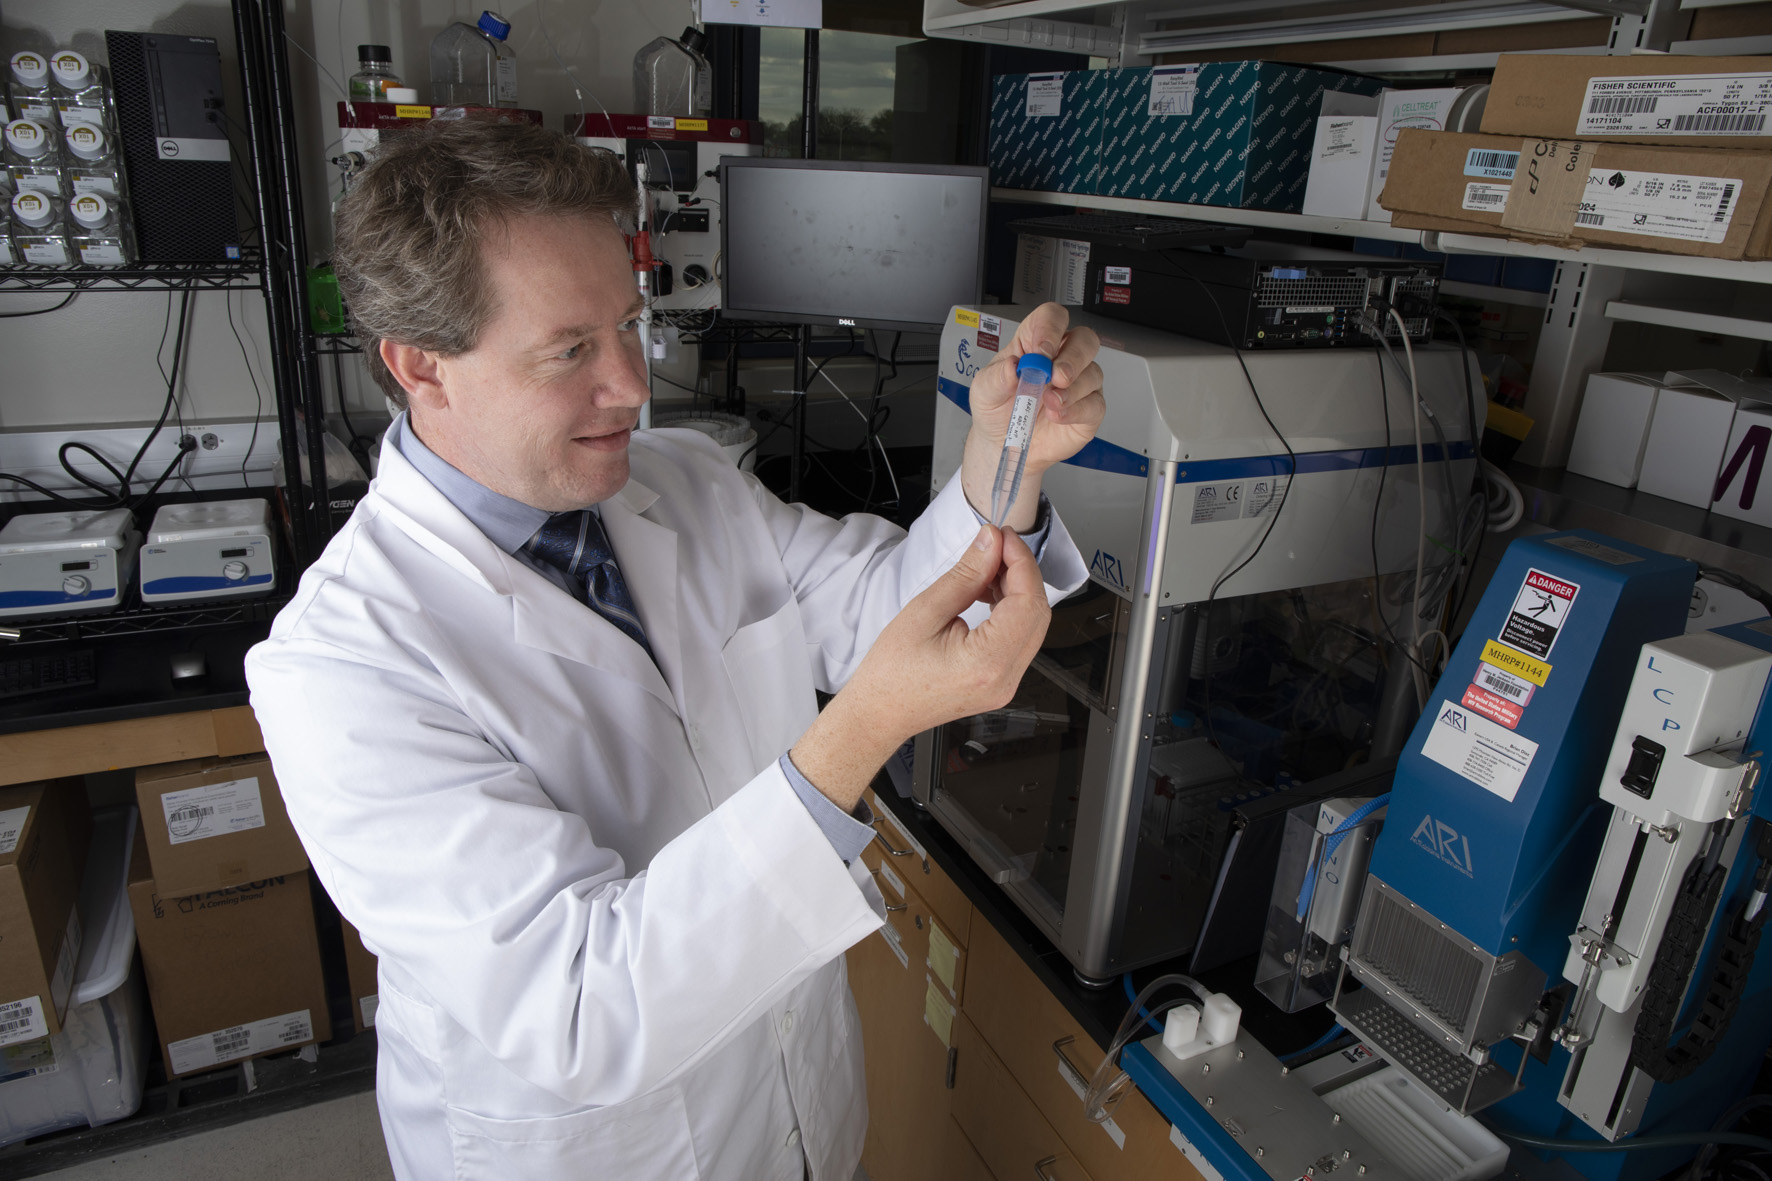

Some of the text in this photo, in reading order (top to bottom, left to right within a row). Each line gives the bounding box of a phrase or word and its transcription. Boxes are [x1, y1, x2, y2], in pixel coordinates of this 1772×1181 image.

[1084, 67, 1101, 92] QIAGEN
[1228, 60, 1250, 85] QIAGEN
[1268, 71, 1288, 94] QIAGEN
[1004, 82, 1016, 101] QIAGEN
[1068, 81, 1081, 102] QIAGEN
[1122, 76, 1138, 98] QIAGEN
[1205, 73, 1224, 98] QIAGEN
[1240, 80, 1262, 106] QIAGEN
[1626, 81, 1676, 90] SCIENTIFIC
[1012, 98, 1023, 117] QIAGEN
[1076, 98, 1090, 119] QIAGEN
[1132, 94, 1146, 116] QIAGEN
[1215, 94, 1234, 118] QIAGEN
[1253, 104, 1275, 128] QIAGEN
[1280, 94, 1300, 117] QIAGEN
[1401, 101, 1438, 112] CELLTREAT
[1059, 110, 1072, 130] QIAGEN
[1085, 116, 1099, 137] QIAGEN
[1113, 106, 1128, 128] QIAGEN
[1192, 108, 1210, 131] QIAGEN
[1226, 114, 1246, 139] QIAGEN
[1027, 131, 1039, 150] QIAGEN
[1042, 121, 1055, 140] QIAGEN
[1067, 128, 1081, 148] QIAGEN
[1122, 124, 1136, 146] QIAGEN
[1170, 120, 1187, 143] QIAGEN
[1202, 128, 1221, 152] QIAGEN
[1266, 127, 1286, 150] QIAGEN
[1051, 138, 1064, 158] QIAGEN
[1104, 136, 1118, 157] QIAGEN
[1130, 144, 1146, 165] QIAGEN
[1150, 132, 1166, 155] QIAGEN
[1181, 140, 1198, 163] QIAGEN
[1238, 137, 1261, 160] QIAGEN
[1059, 155, 1072, 175] QIAGEN
[1076, 145, 1090, 166] QIAGEN
[1112, 154, 1126, 176] QIAGEN
[1160, 152, 1176, 174] QIAGEN
[1214, 149, 1232, 172] QIAGEN
[1084, 163, 1100, 184] QIAGEN
[1140, 163, 1156, 184] QIAGEN
[1192, 160, 1209, 183] QIAGEN
[1225, 170, 1245, 194] QIAGEN
[1252, 160, 1272, 182] QIAGEN
[1483, 169, 1513, 178] X1021448
[1068, 173, 1081, 192] QIAGEN
[1121, 174, 1136, 194] QIAGEN
[1170, 172, 1186, 194] QIAGEN
[1203, 181, 1220, 203] QIAGEN
[838, 318, 856, 326] DELL
[1199, 487, 1217, 497] ARI
[1253, 482, 1268, 493] ARI
[1090, 549, 1124, 588] ARI
[1537, 578, 1573, 598] DANGER
[1509, 620, 1535, 636] Voltage.
[1512, 615, 1545, 633] Hazardous
[1504, 632, 1543, 652] before servicing.
[1506, 628, 1548, 649] Disconnect power
[1488, 648, 1543, 678] MHRP#1144
[1474, 695, 1488, 705] United
[1487, 701, 1501, 711] States
[1501, 706, 1518, 720] Military
[1483, 692, 1500, 703] Property
[1441, 708, 1467, 731] ARI
[1475, 702, 1494, 715] Research
[1494, 711, 1511, 724] Program
[1509, 744, 1530, 757] Brian Diaz
[1409, 814, 1473, 873] ARI
[200, 890, 265, 910] A Corning Brand
